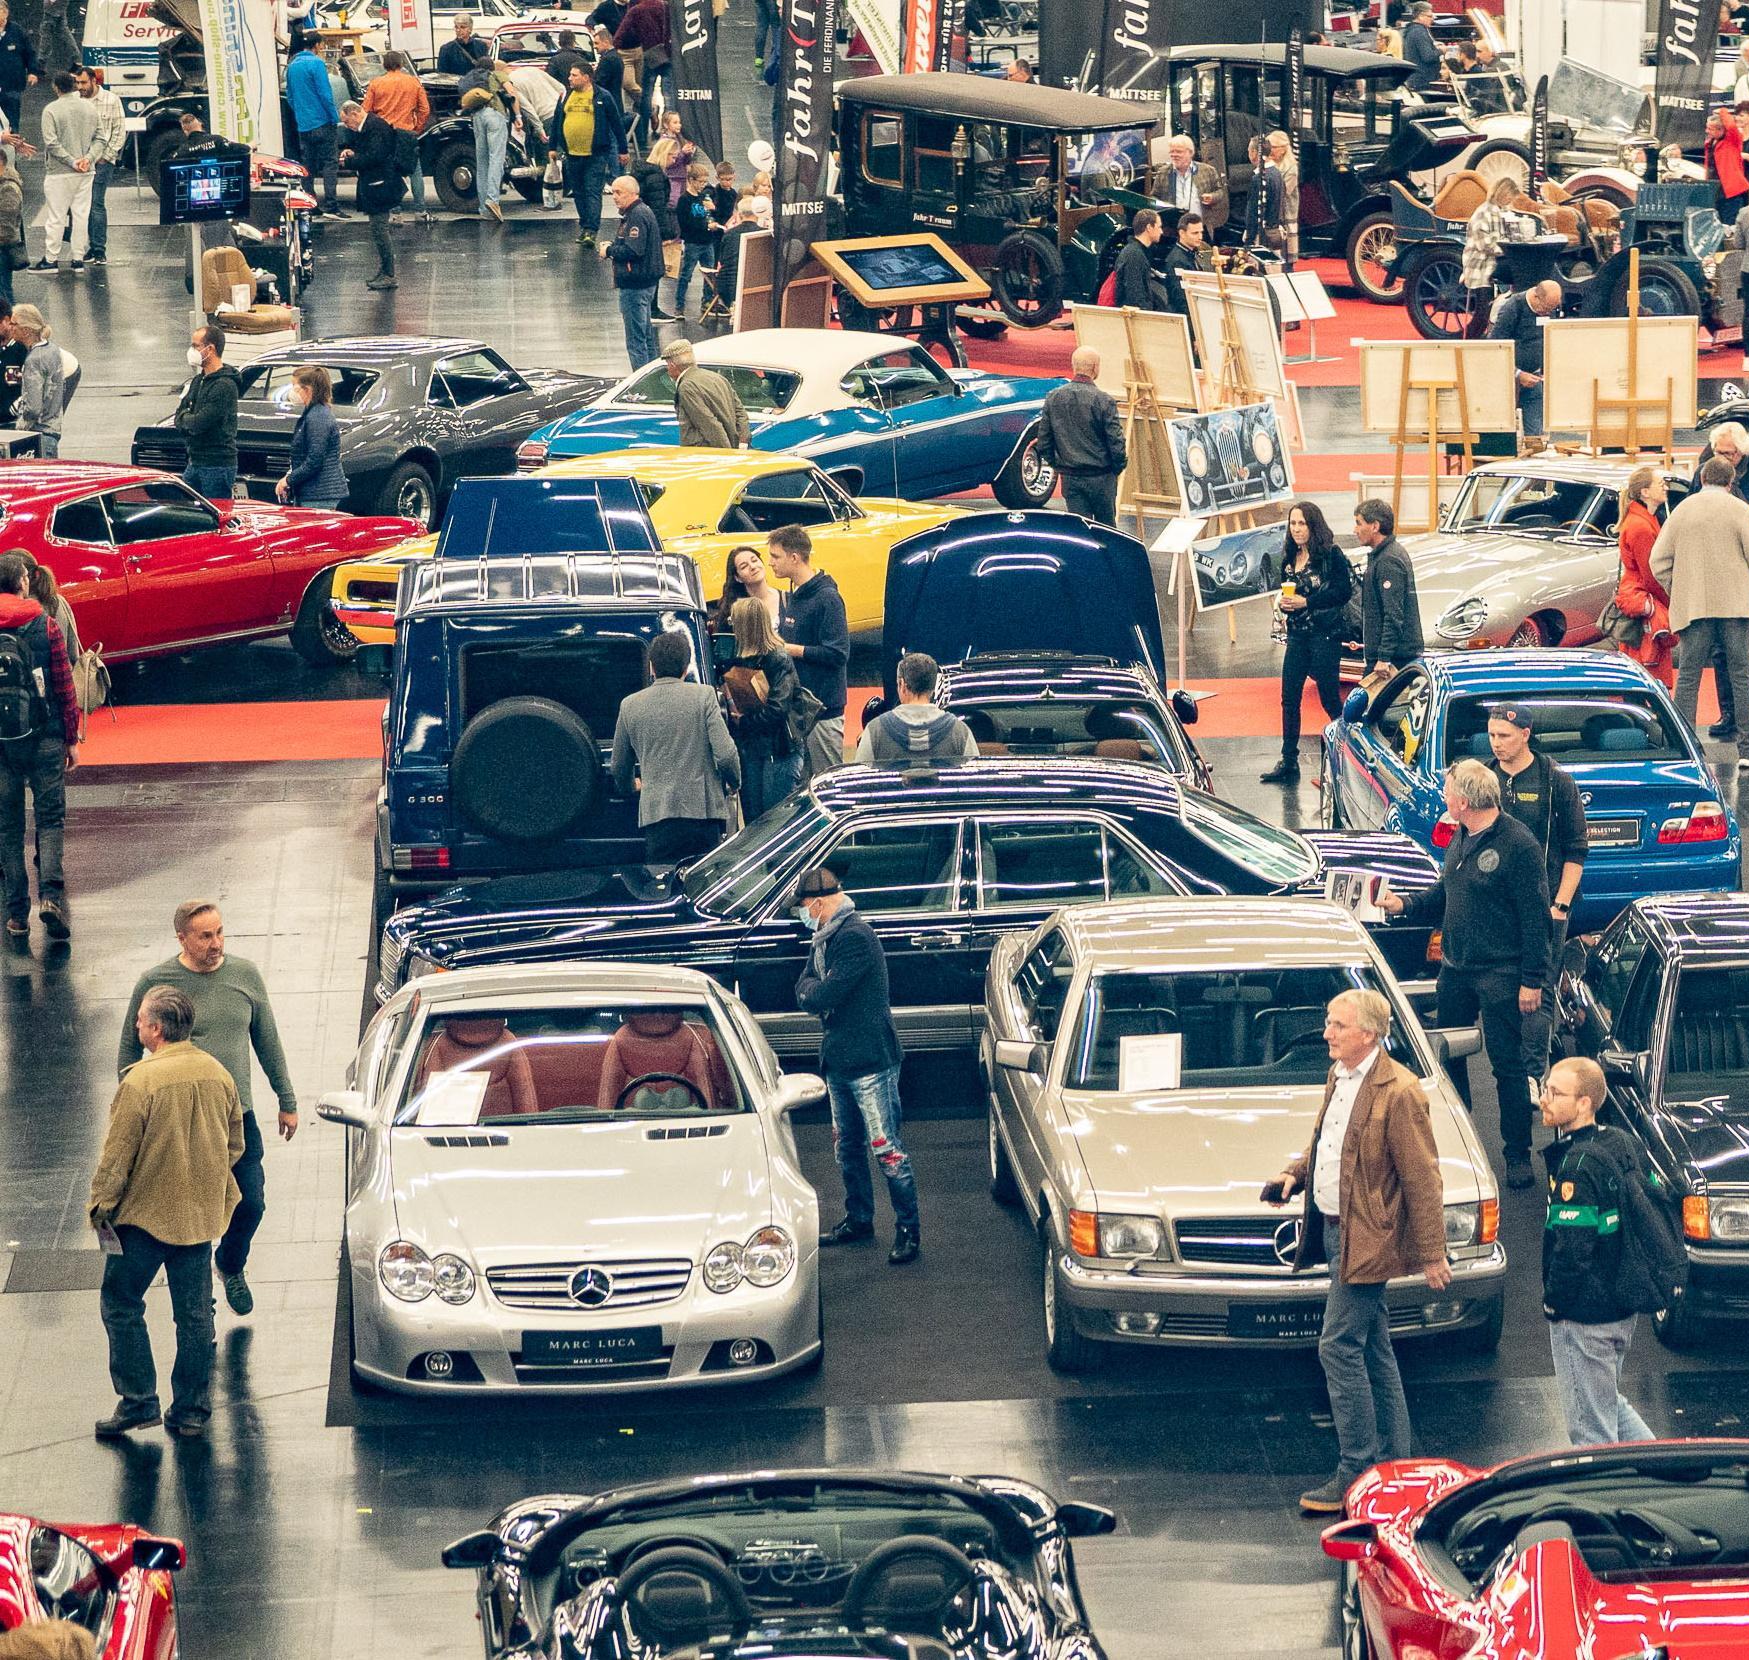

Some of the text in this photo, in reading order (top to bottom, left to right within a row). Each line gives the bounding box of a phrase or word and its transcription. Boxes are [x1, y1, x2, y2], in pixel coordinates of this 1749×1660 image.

[123, 24, 182, 38] Servic
[823, 57, 832, 73] DIE
[1109, 88, 1161, 101] MATTSEE
[781, 201, 824, 215] MATTSEE
[1256, 1314, 1321, 1323] MARC LU
[549, 1338, 636, 1350] MARC LUCA
